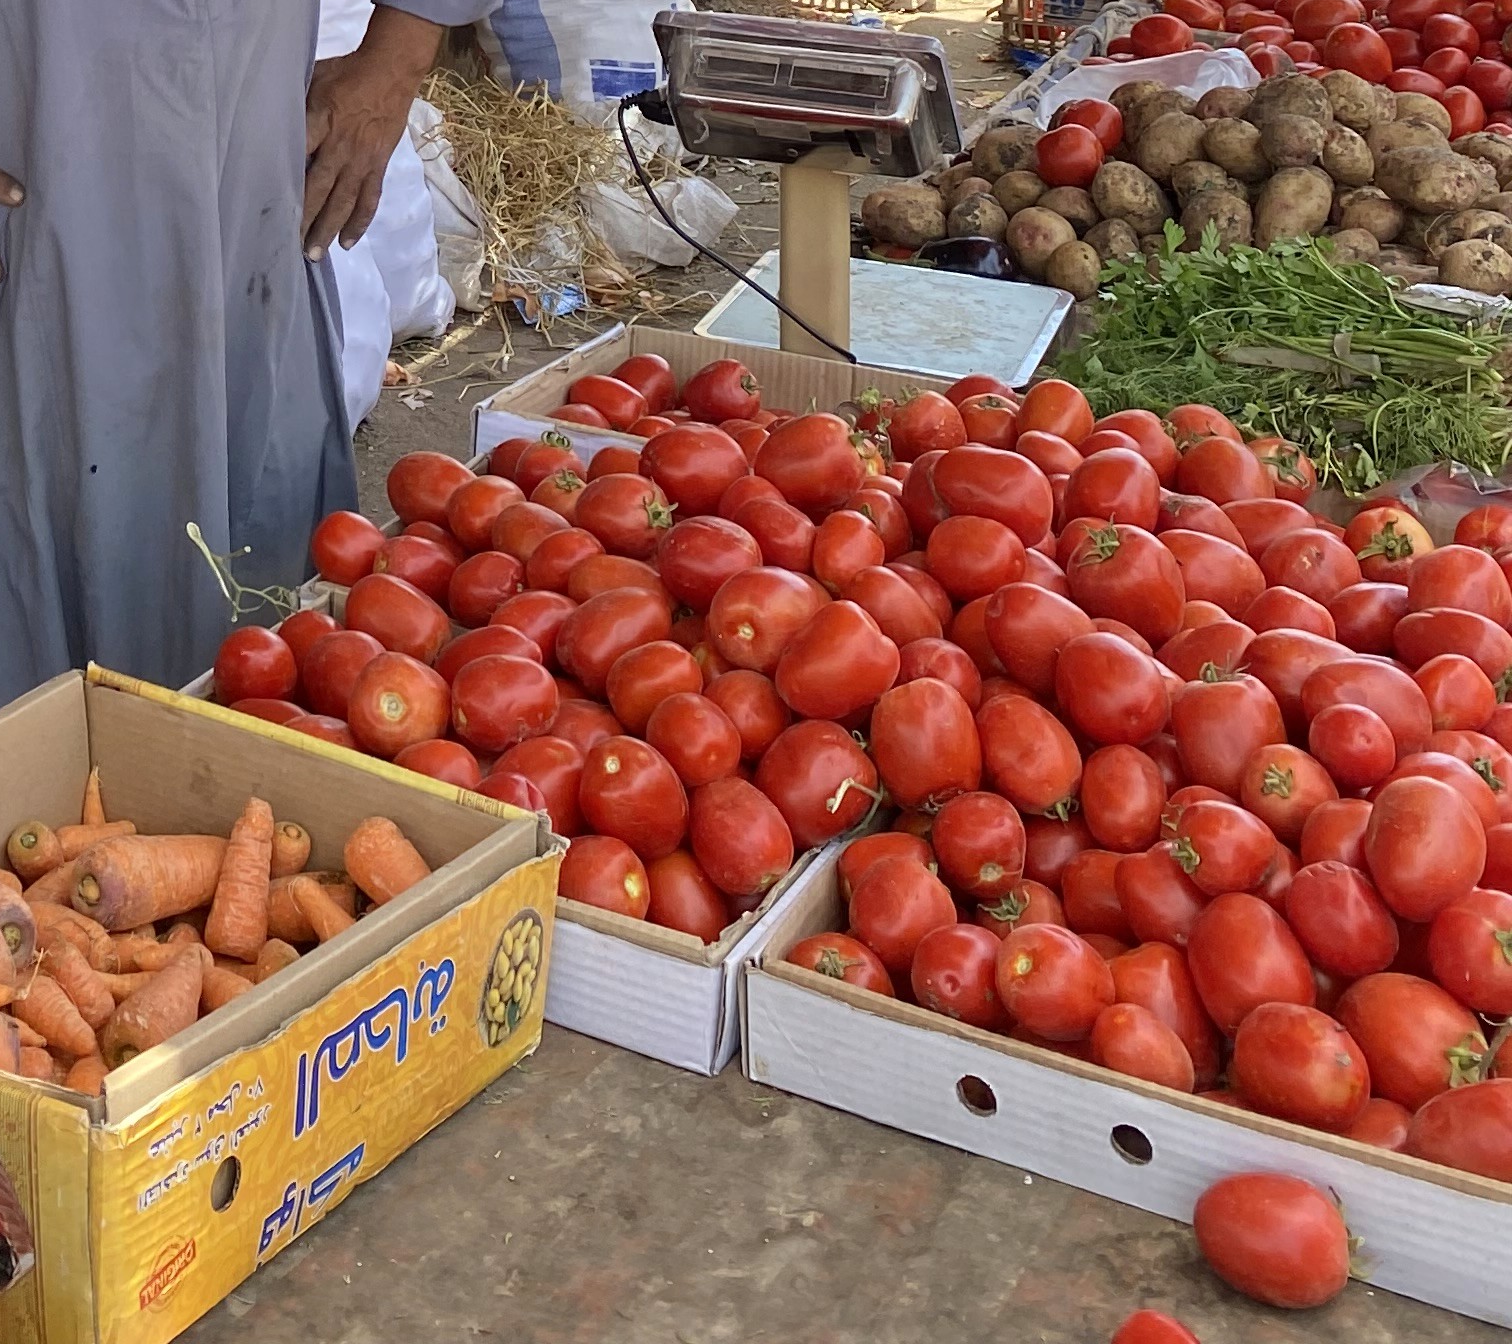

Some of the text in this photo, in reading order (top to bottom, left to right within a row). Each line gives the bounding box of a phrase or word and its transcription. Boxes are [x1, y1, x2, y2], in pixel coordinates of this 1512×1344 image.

[294, 957, 456, 1139] الصحابة
[195, 1133, 225, 1166] سوق
[230, 1105, 270, 1148] العبور
[207, 1083, 241, 1123] محل
[257, 1141, 365, 1257] فواكه
[140, 1239, 196, 1310] ORIGINAL
